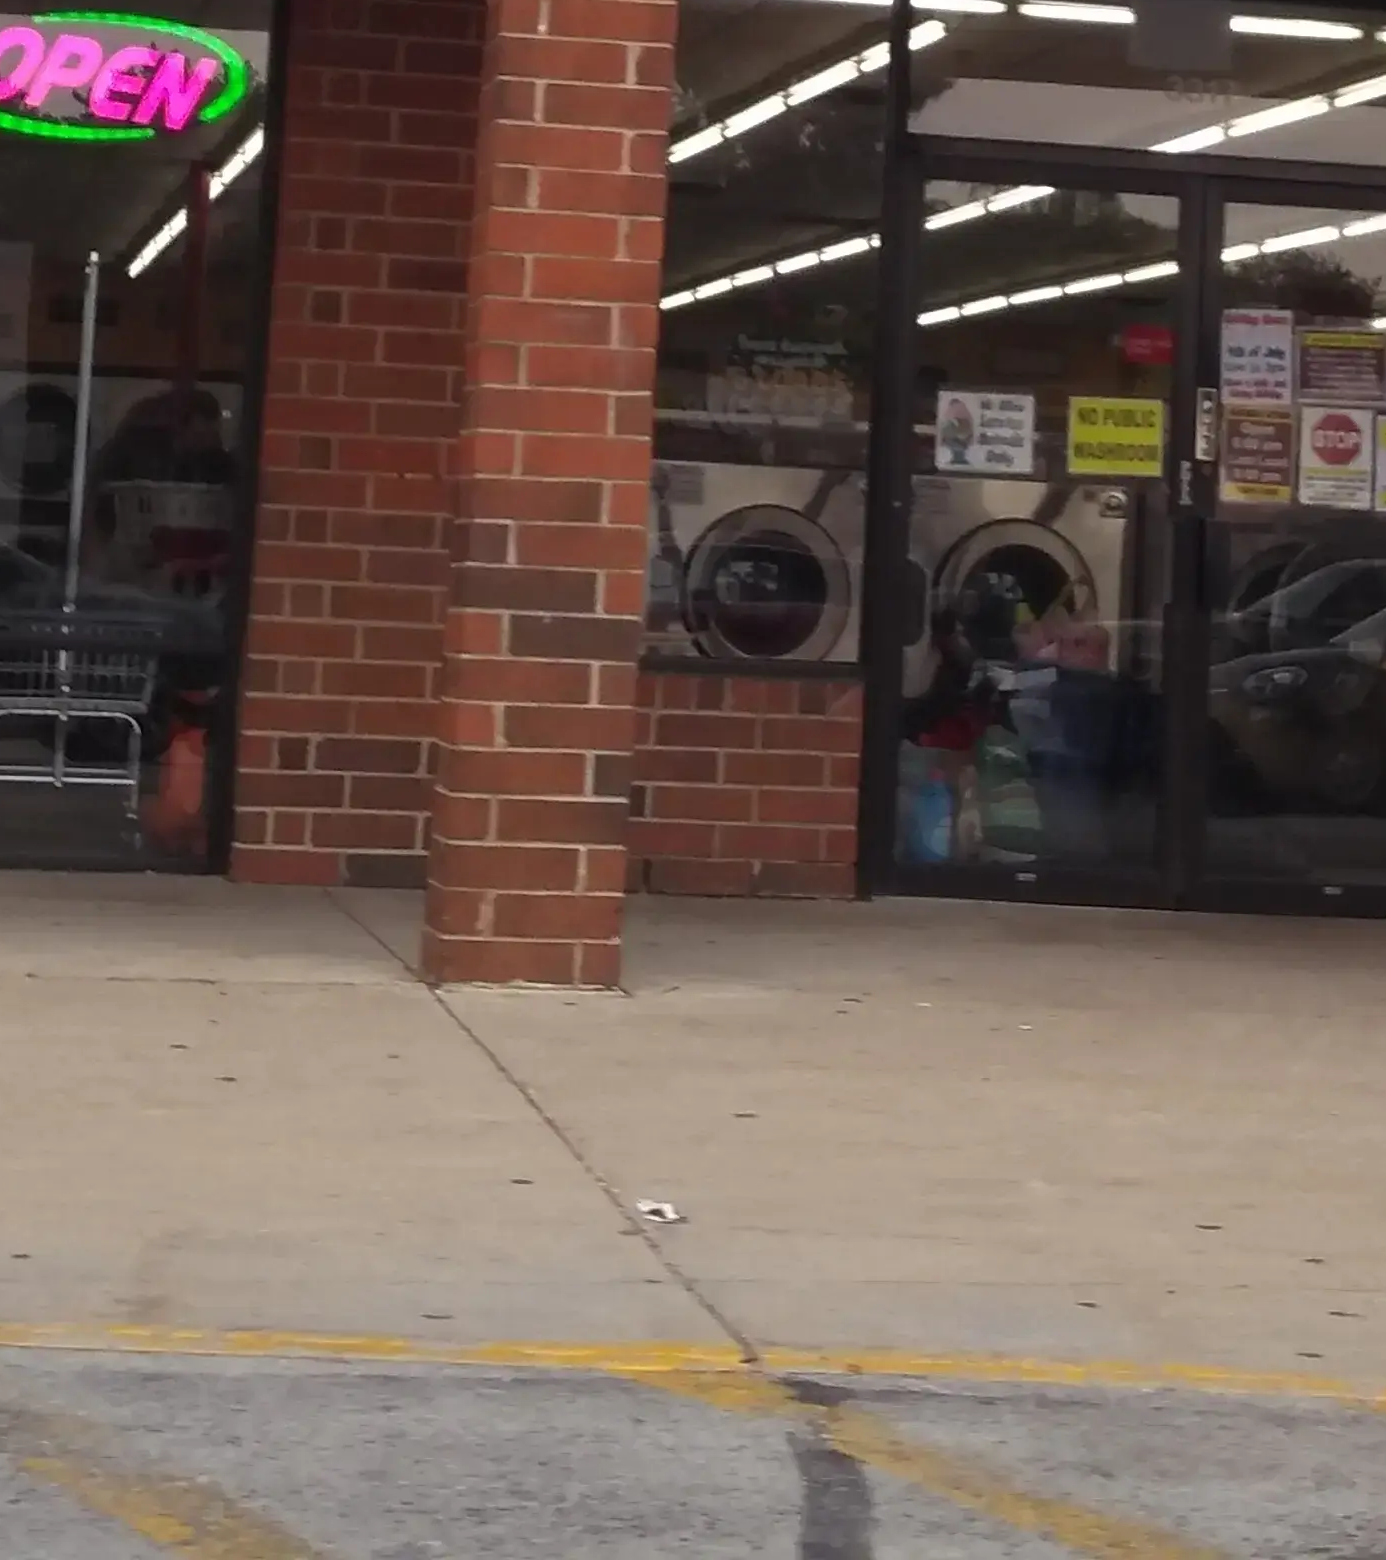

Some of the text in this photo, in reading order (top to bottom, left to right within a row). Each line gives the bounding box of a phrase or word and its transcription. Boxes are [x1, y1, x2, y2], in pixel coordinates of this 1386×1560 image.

[1077, 406, 1157, 429] NO PUBLIC
[1313, 429, 1362, 449] STOP
[1074, 441, 1159, 462] WASHROOM
